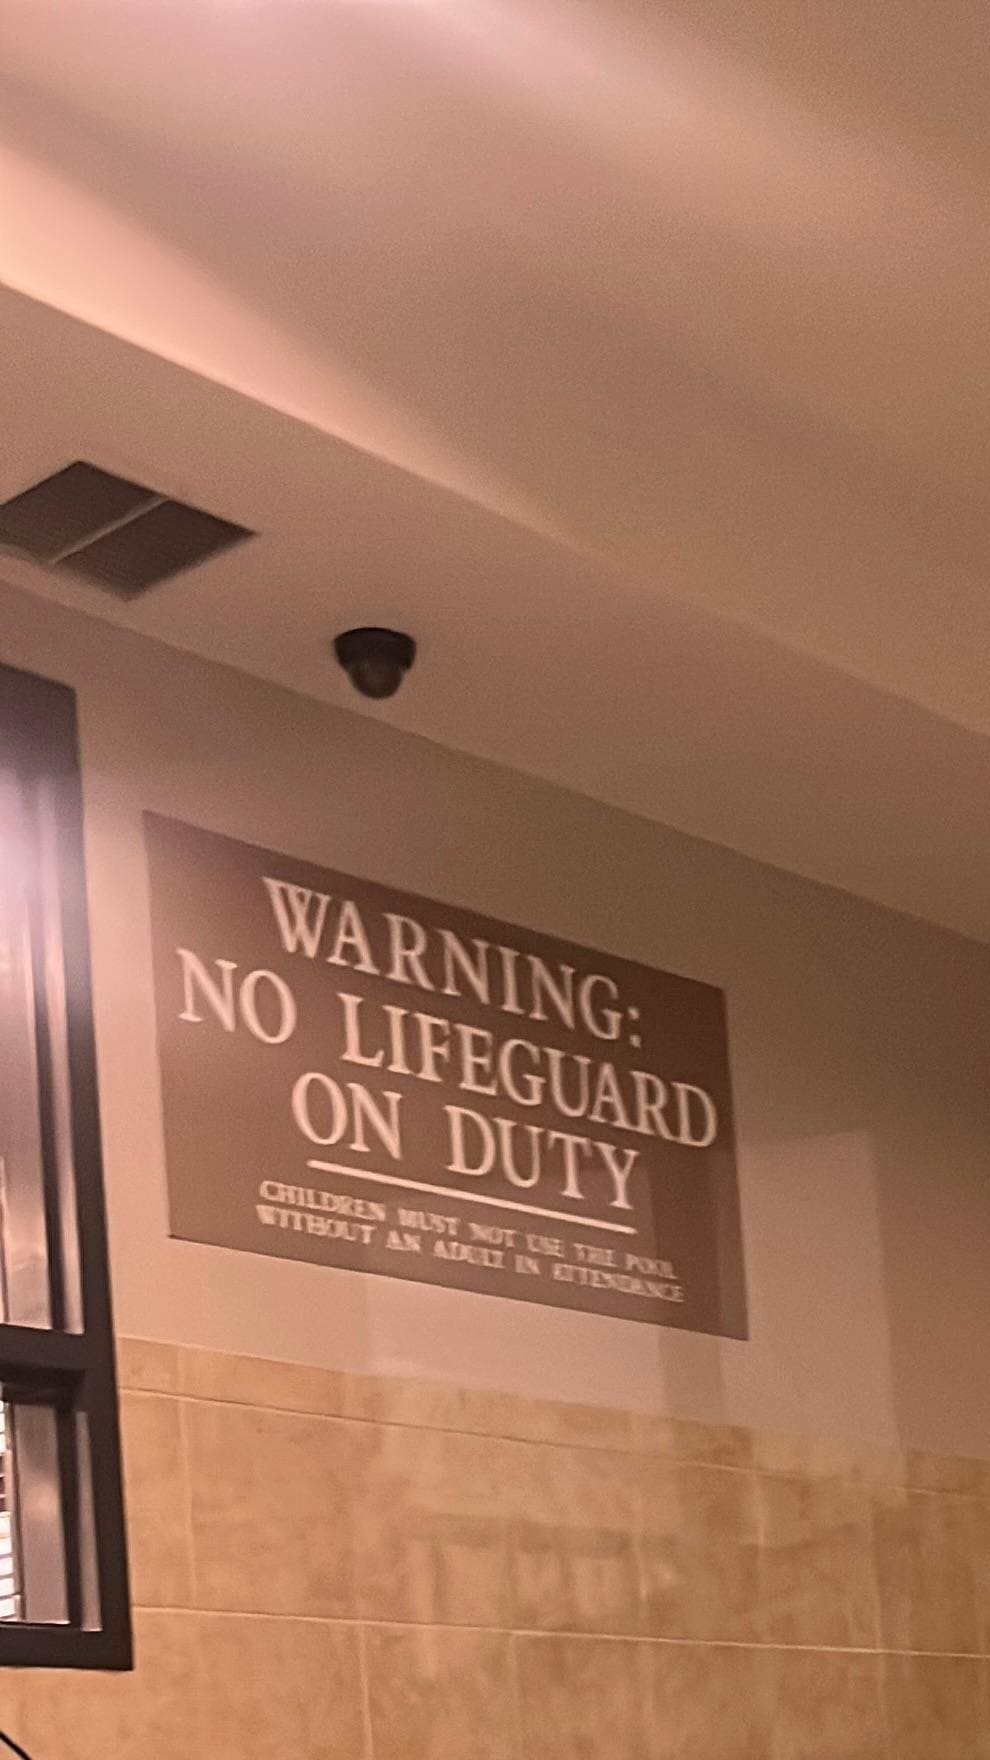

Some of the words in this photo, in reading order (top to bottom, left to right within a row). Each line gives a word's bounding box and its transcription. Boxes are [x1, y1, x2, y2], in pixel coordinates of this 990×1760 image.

[262, 876, 641, 1048] WARNING:
[177, 947, 297, 1043] NO
[337, 992, 718, 1147] LIFEGUARD
[292, 1072, 402, 1160] ON
[444, 1104, 640, 1210] DUTY
[255, 1204, 376, 1244] WITHOUT
[384, 1230, 422, 1252] AN
[433, 1239, 505, 1269] ADULT
[514, 1254, 541, 1275] IN
[552, 1262, 685, 1302] ATTENDANCE
[259, 1180, 386, 1221] CHILDREN
[397, 1207, 460, 1236] MUST
[468, 1222, 517, 1247] NOT
[526, 1233, 564, 1257] USE
[573, 1242, 617, 1267] THE
[625, 1252, 678, 1279] POOL
